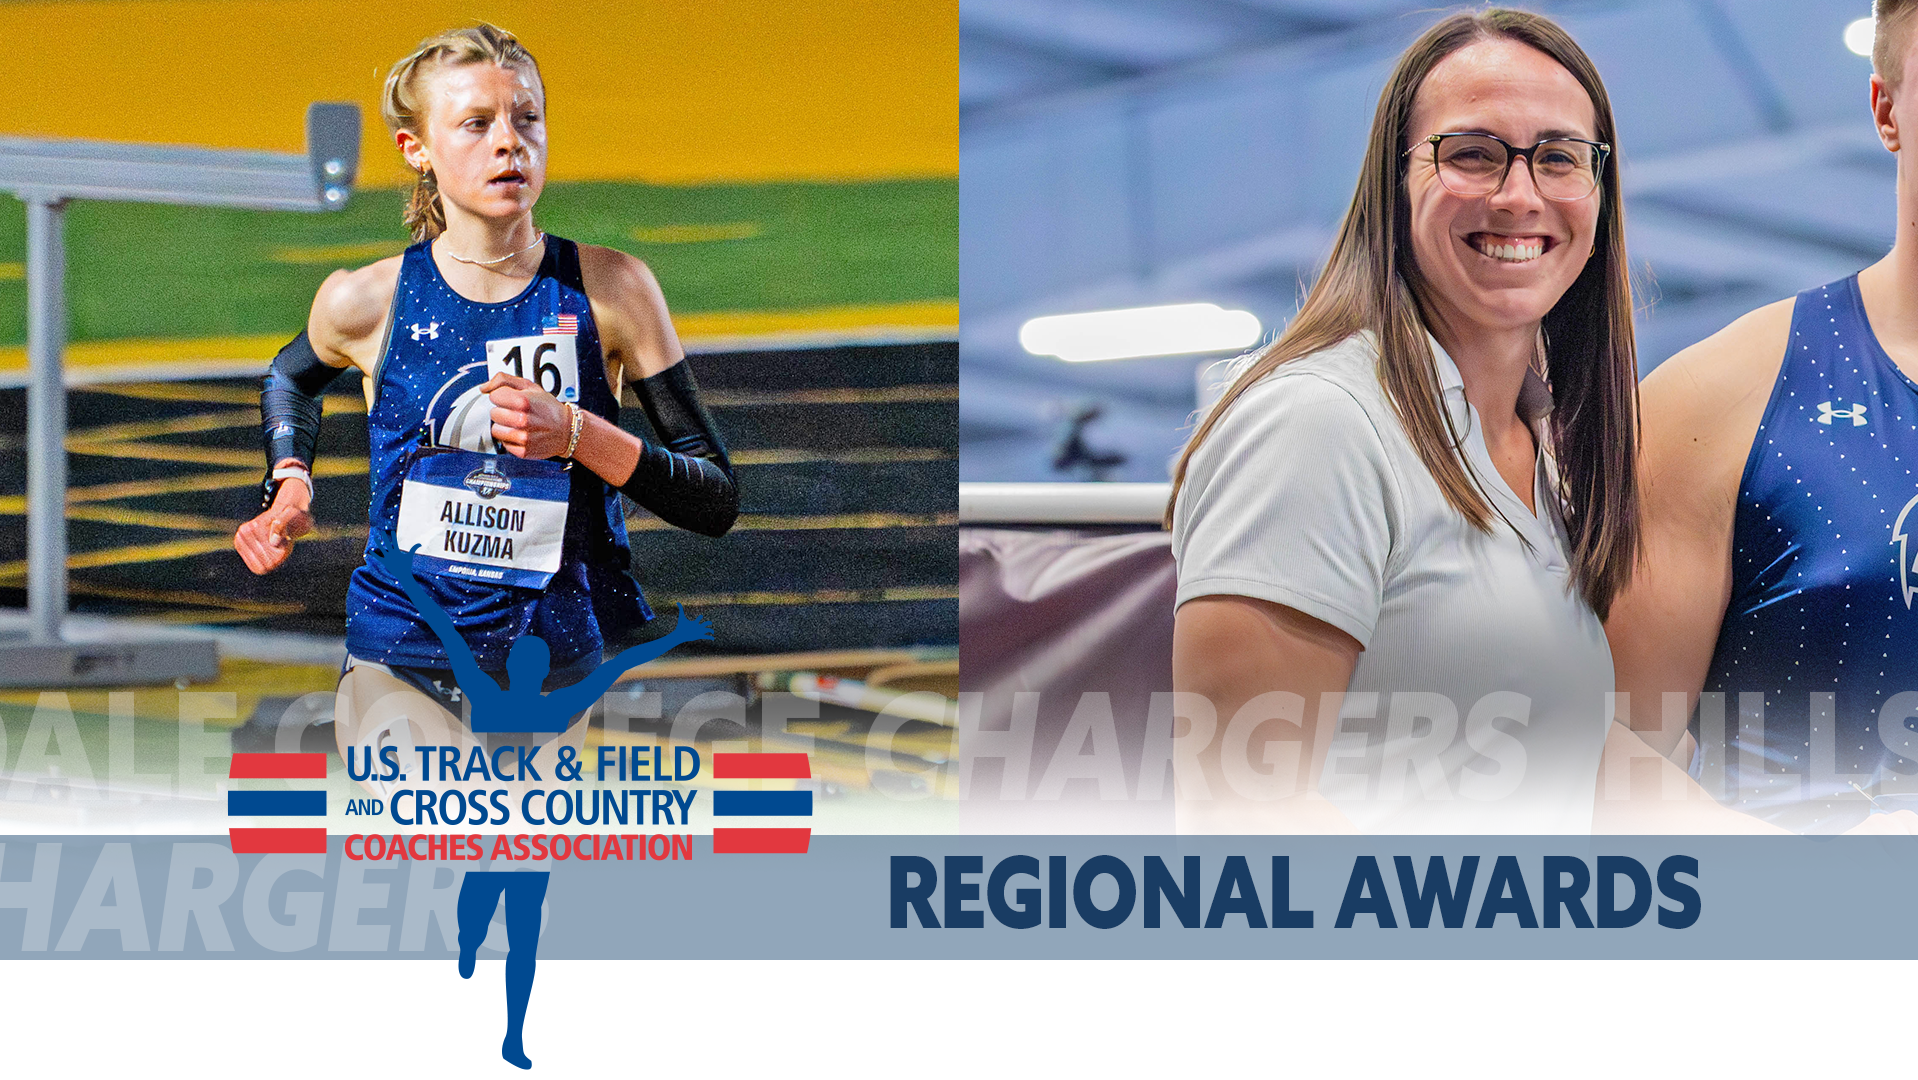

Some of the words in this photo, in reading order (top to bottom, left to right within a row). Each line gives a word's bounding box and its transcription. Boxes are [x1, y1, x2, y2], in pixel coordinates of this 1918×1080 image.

[502, 342, 561, 398] 16
[440, 501, 525, 532] ALLISON
[444, 530, 514, 560] KUZMA
[478, 569, 504, 580] KANSAS
